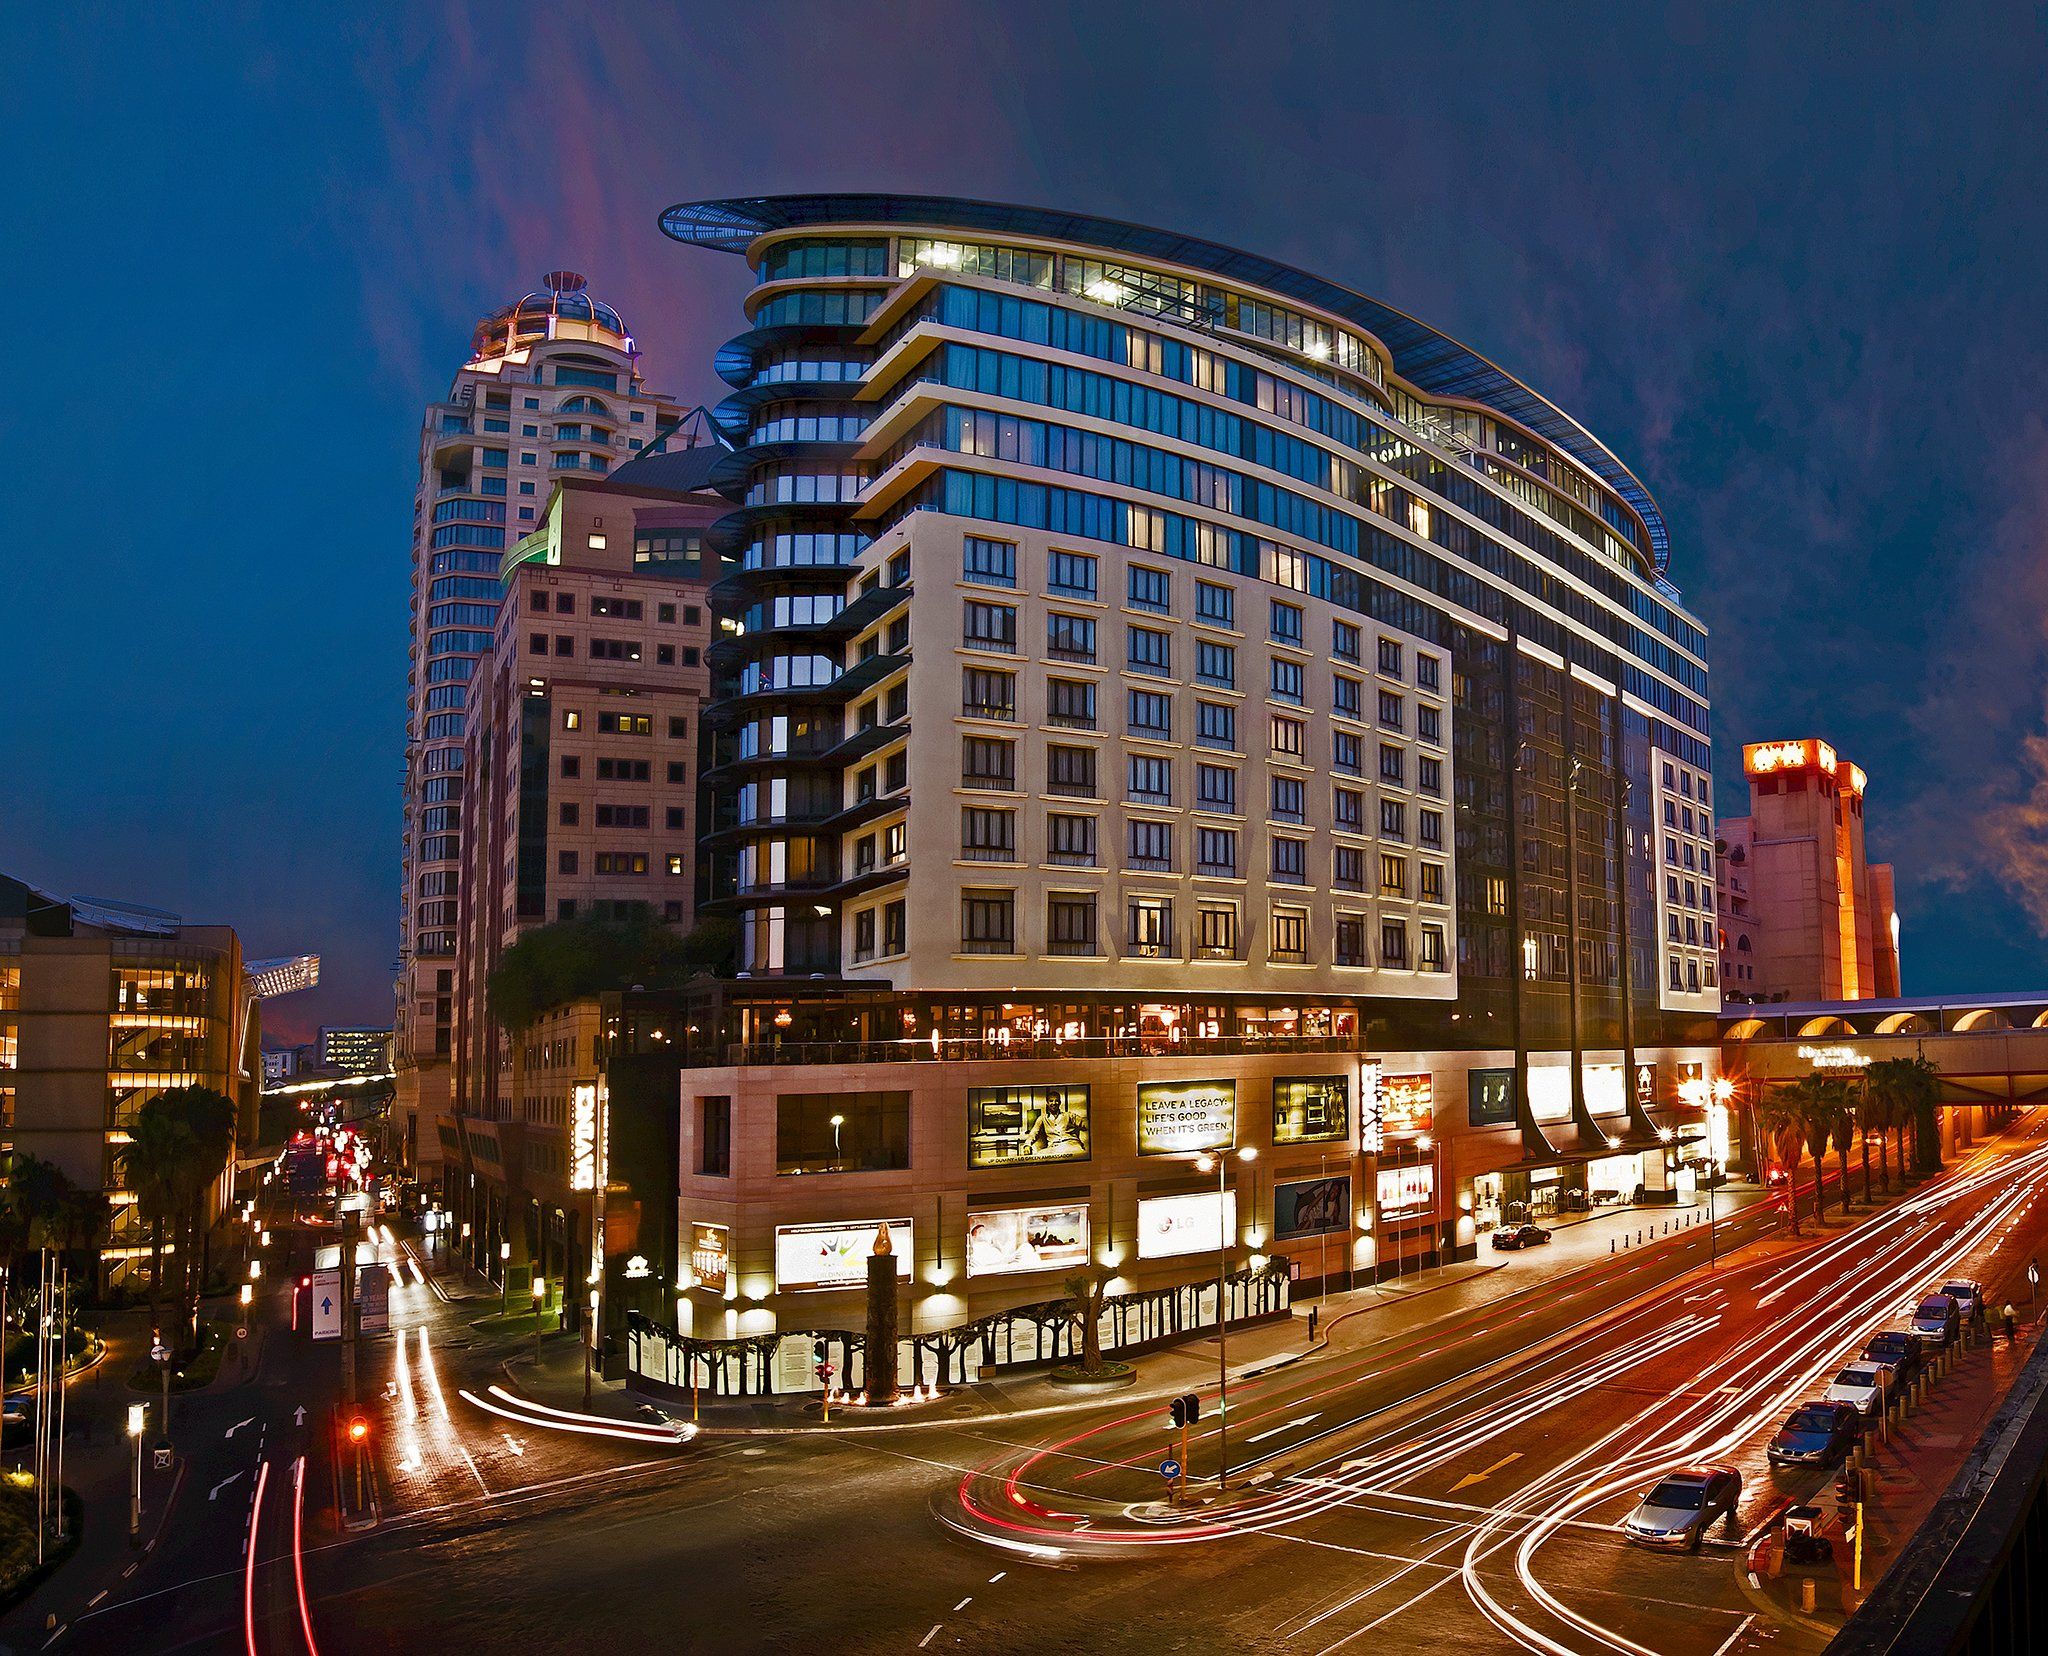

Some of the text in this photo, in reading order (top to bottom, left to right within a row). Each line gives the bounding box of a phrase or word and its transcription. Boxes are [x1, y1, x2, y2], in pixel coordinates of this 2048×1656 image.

[1145, 1097, 1228, 1111] LEAVE A LEGACY:
[1145, 1111, 1207, 1124] LIFE'S GOOD
[1145, 1122, 1230, 1136] WHEN IT'S GREEN.
[1176, 1216, 1195, 1229] LG
[314, 1328, 340, 1336] PARKING
